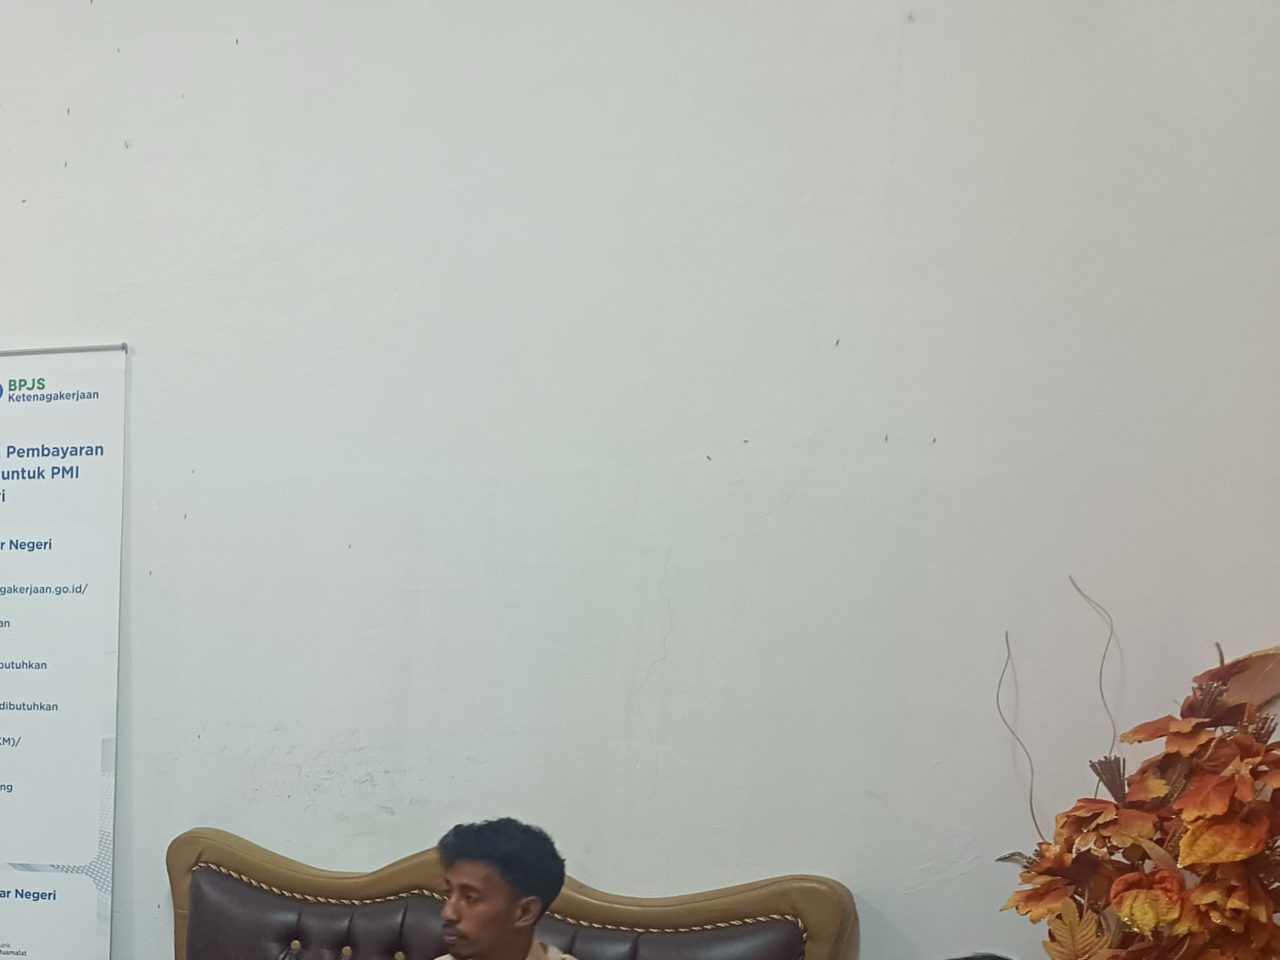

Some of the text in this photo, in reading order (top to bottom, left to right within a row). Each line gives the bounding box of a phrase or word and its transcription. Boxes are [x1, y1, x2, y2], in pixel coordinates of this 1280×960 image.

[8, 378, 46, 391] BPJS
[8, 390, 99, 402] Ketenagakerjaan
[7, 444, 104, 460] Pembayaran
[1, 467, 45, 480] untuk
[51, 466, 80, 479] PMI
[9, 539, 52, 553] Negeri
[15, 889, 56, 901] Negeri
